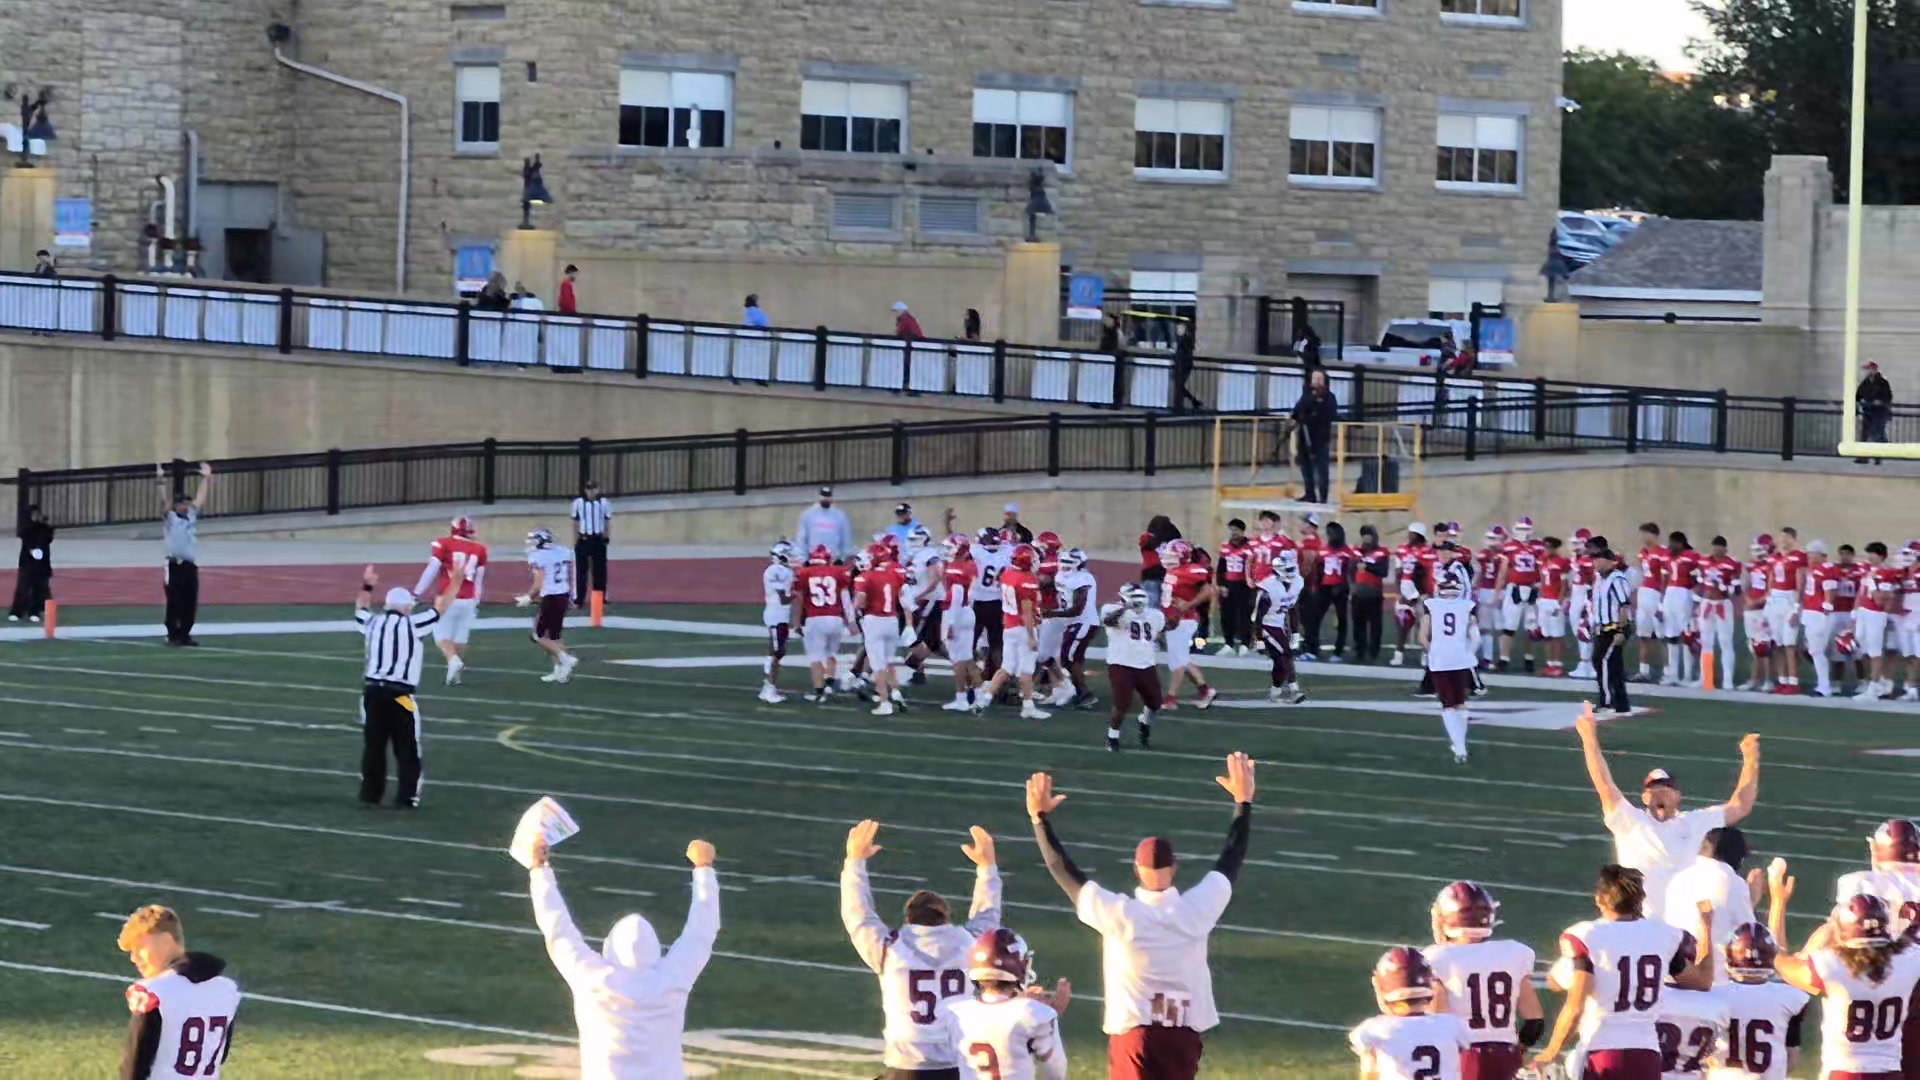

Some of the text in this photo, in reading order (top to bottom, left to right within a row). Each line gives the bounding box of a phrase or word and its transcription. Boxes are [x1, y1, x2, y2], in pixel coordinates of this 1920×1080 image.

[808, 575, 837, 607] 53
[883, 583, 892, 613] 1
[1443, 612, 1456, 636] 9
[1467, 971, 1512, 1029] 18
[1614, 955, 1662, 1012] 18
[1846, 996, 1903, 1043] 80
[174, 1016, 228, 1076] 87
[1725, 1018, 1774, 1073] 16
